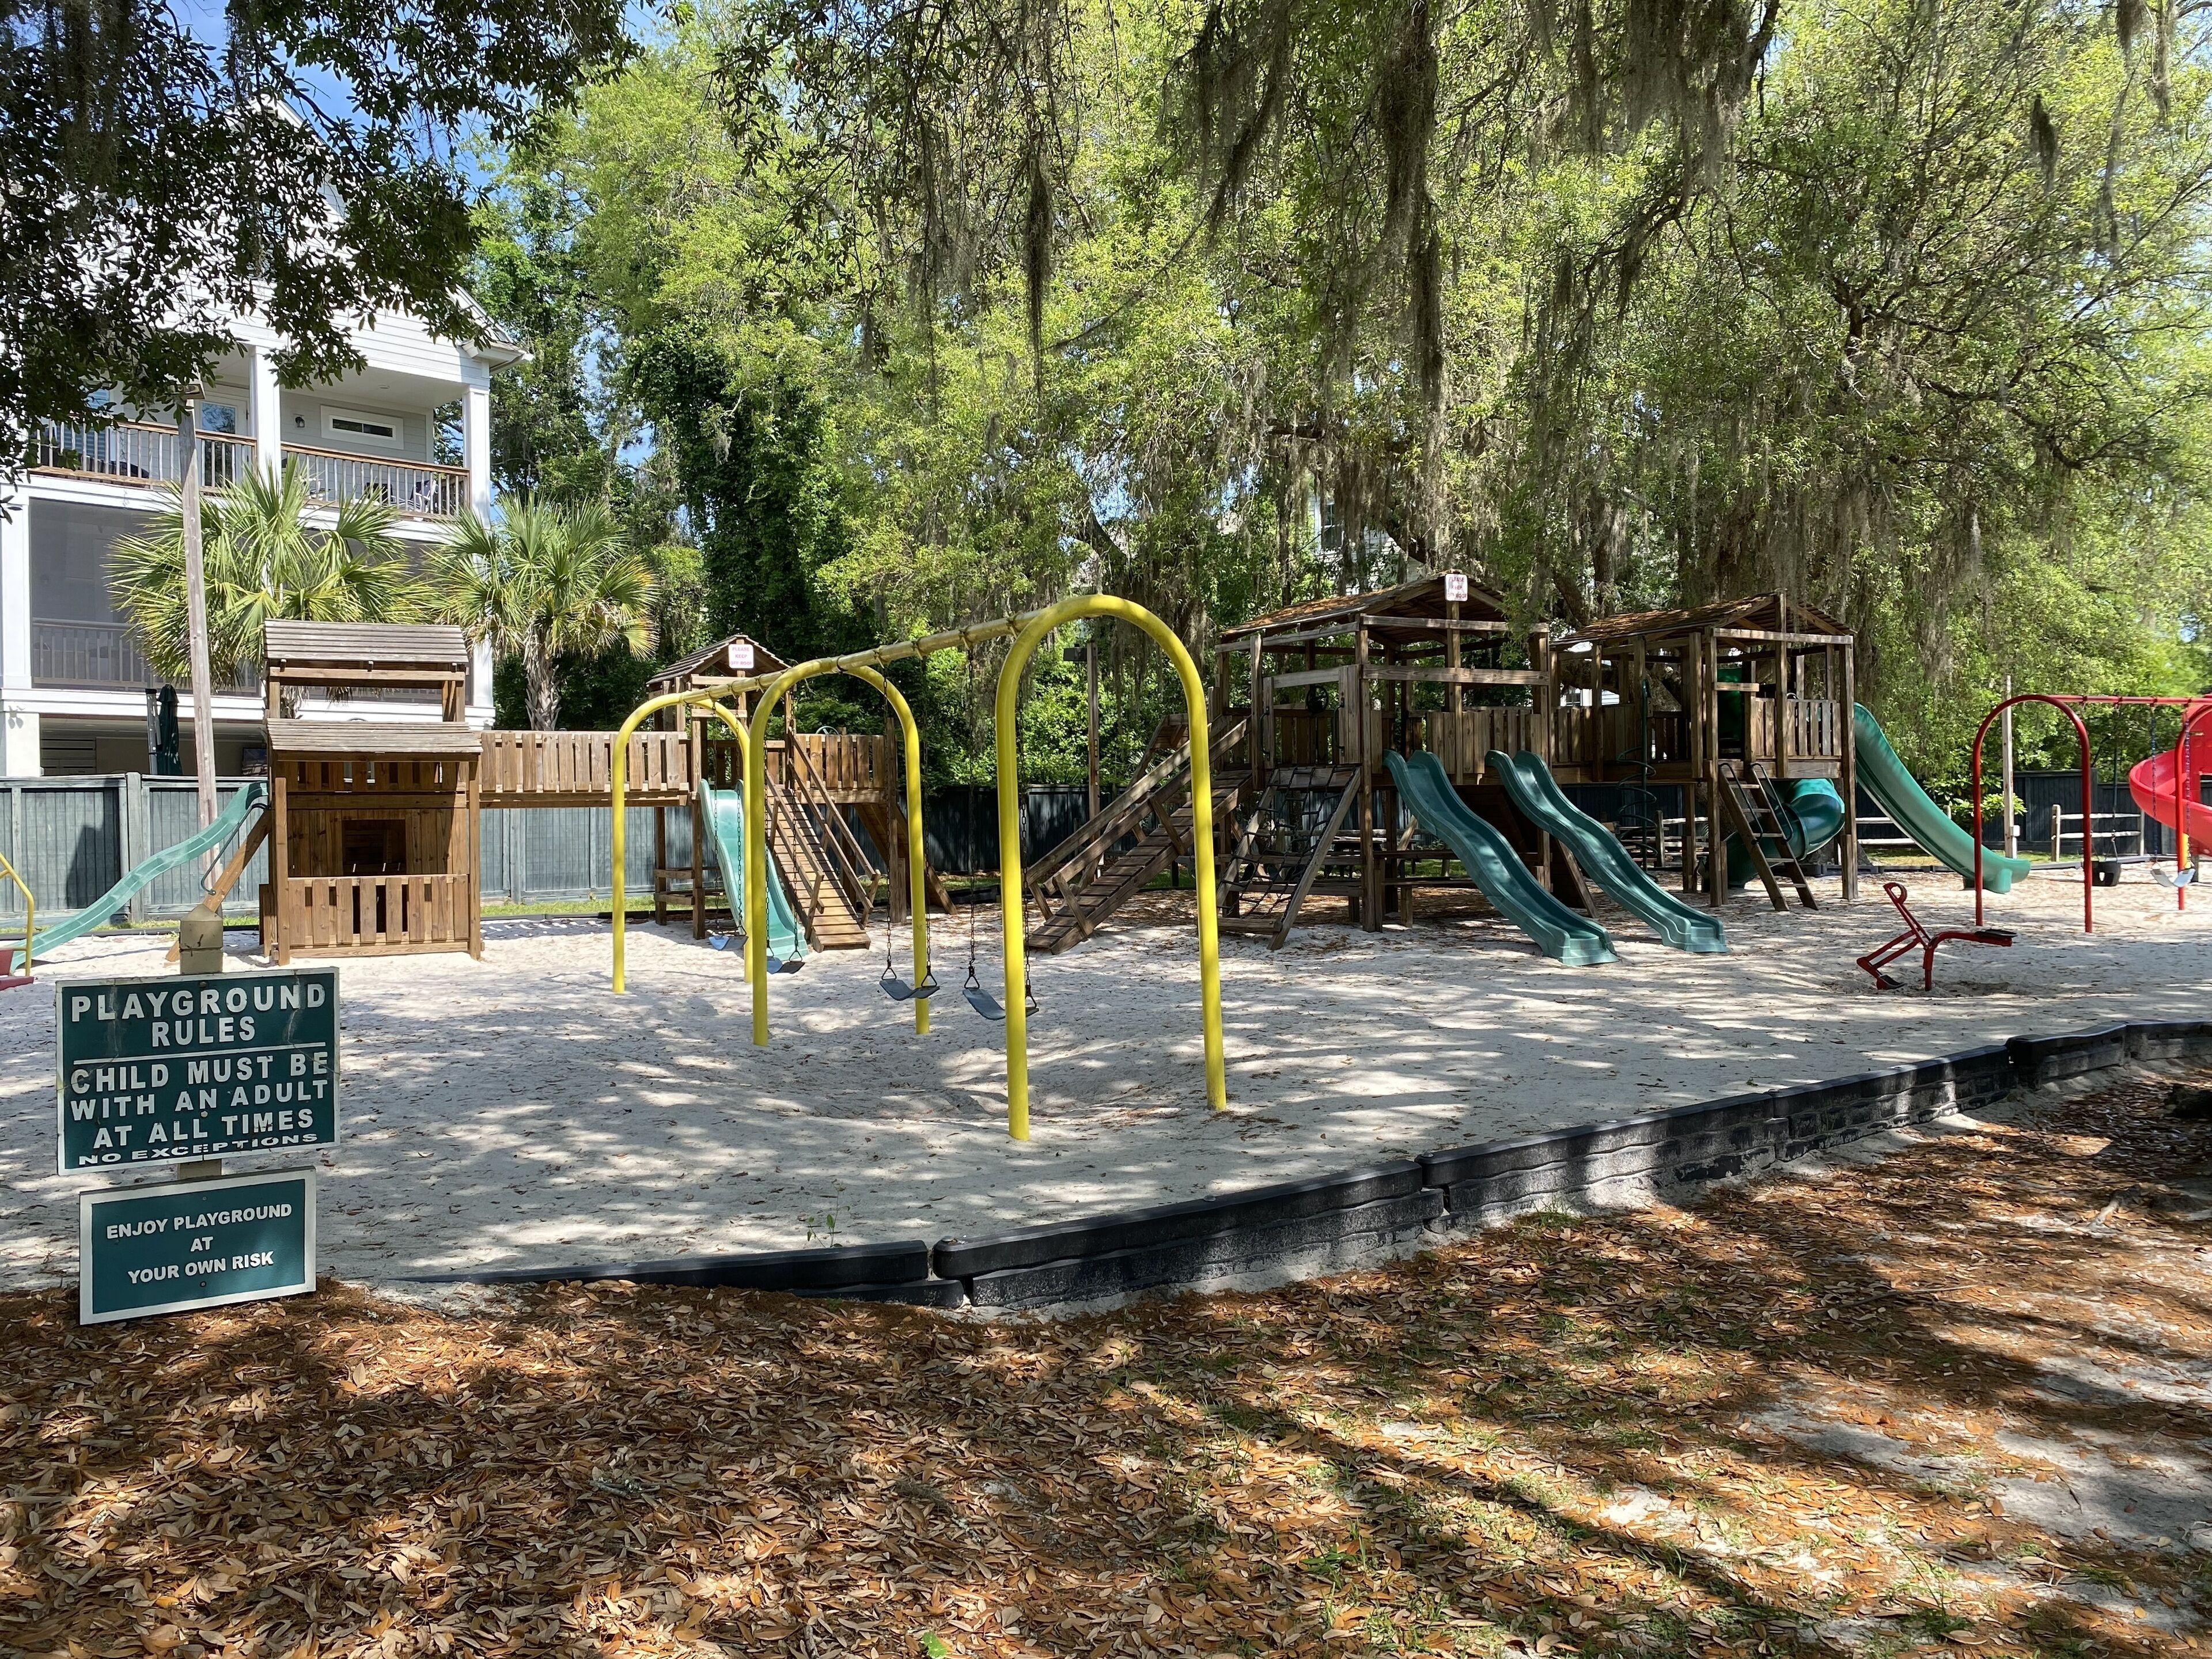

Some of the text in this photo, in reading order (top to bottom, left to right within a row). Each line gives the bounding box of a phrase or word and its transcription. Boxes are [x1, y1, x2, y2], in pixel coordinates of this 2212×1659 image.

[71, 983, 325, 1022] PLAYGROUND
[151, 1016, 255, 1047] RULES
[70, 1051, 328, 1094] CHILD MUST BE
[70, 1080, 328, 1121] WITH AN ADULT
[93, 1108, 313, 1149] AT ALL TIMES
[79, 1134, 317, 1165] NO EXCEPTIONS
[107, 1203, 292, 1239] ENJOY PLAYGROUND
[190, 1236, 214, 1252] AT
[127, 1251, 274, 1284] YOUR OWN RISK
